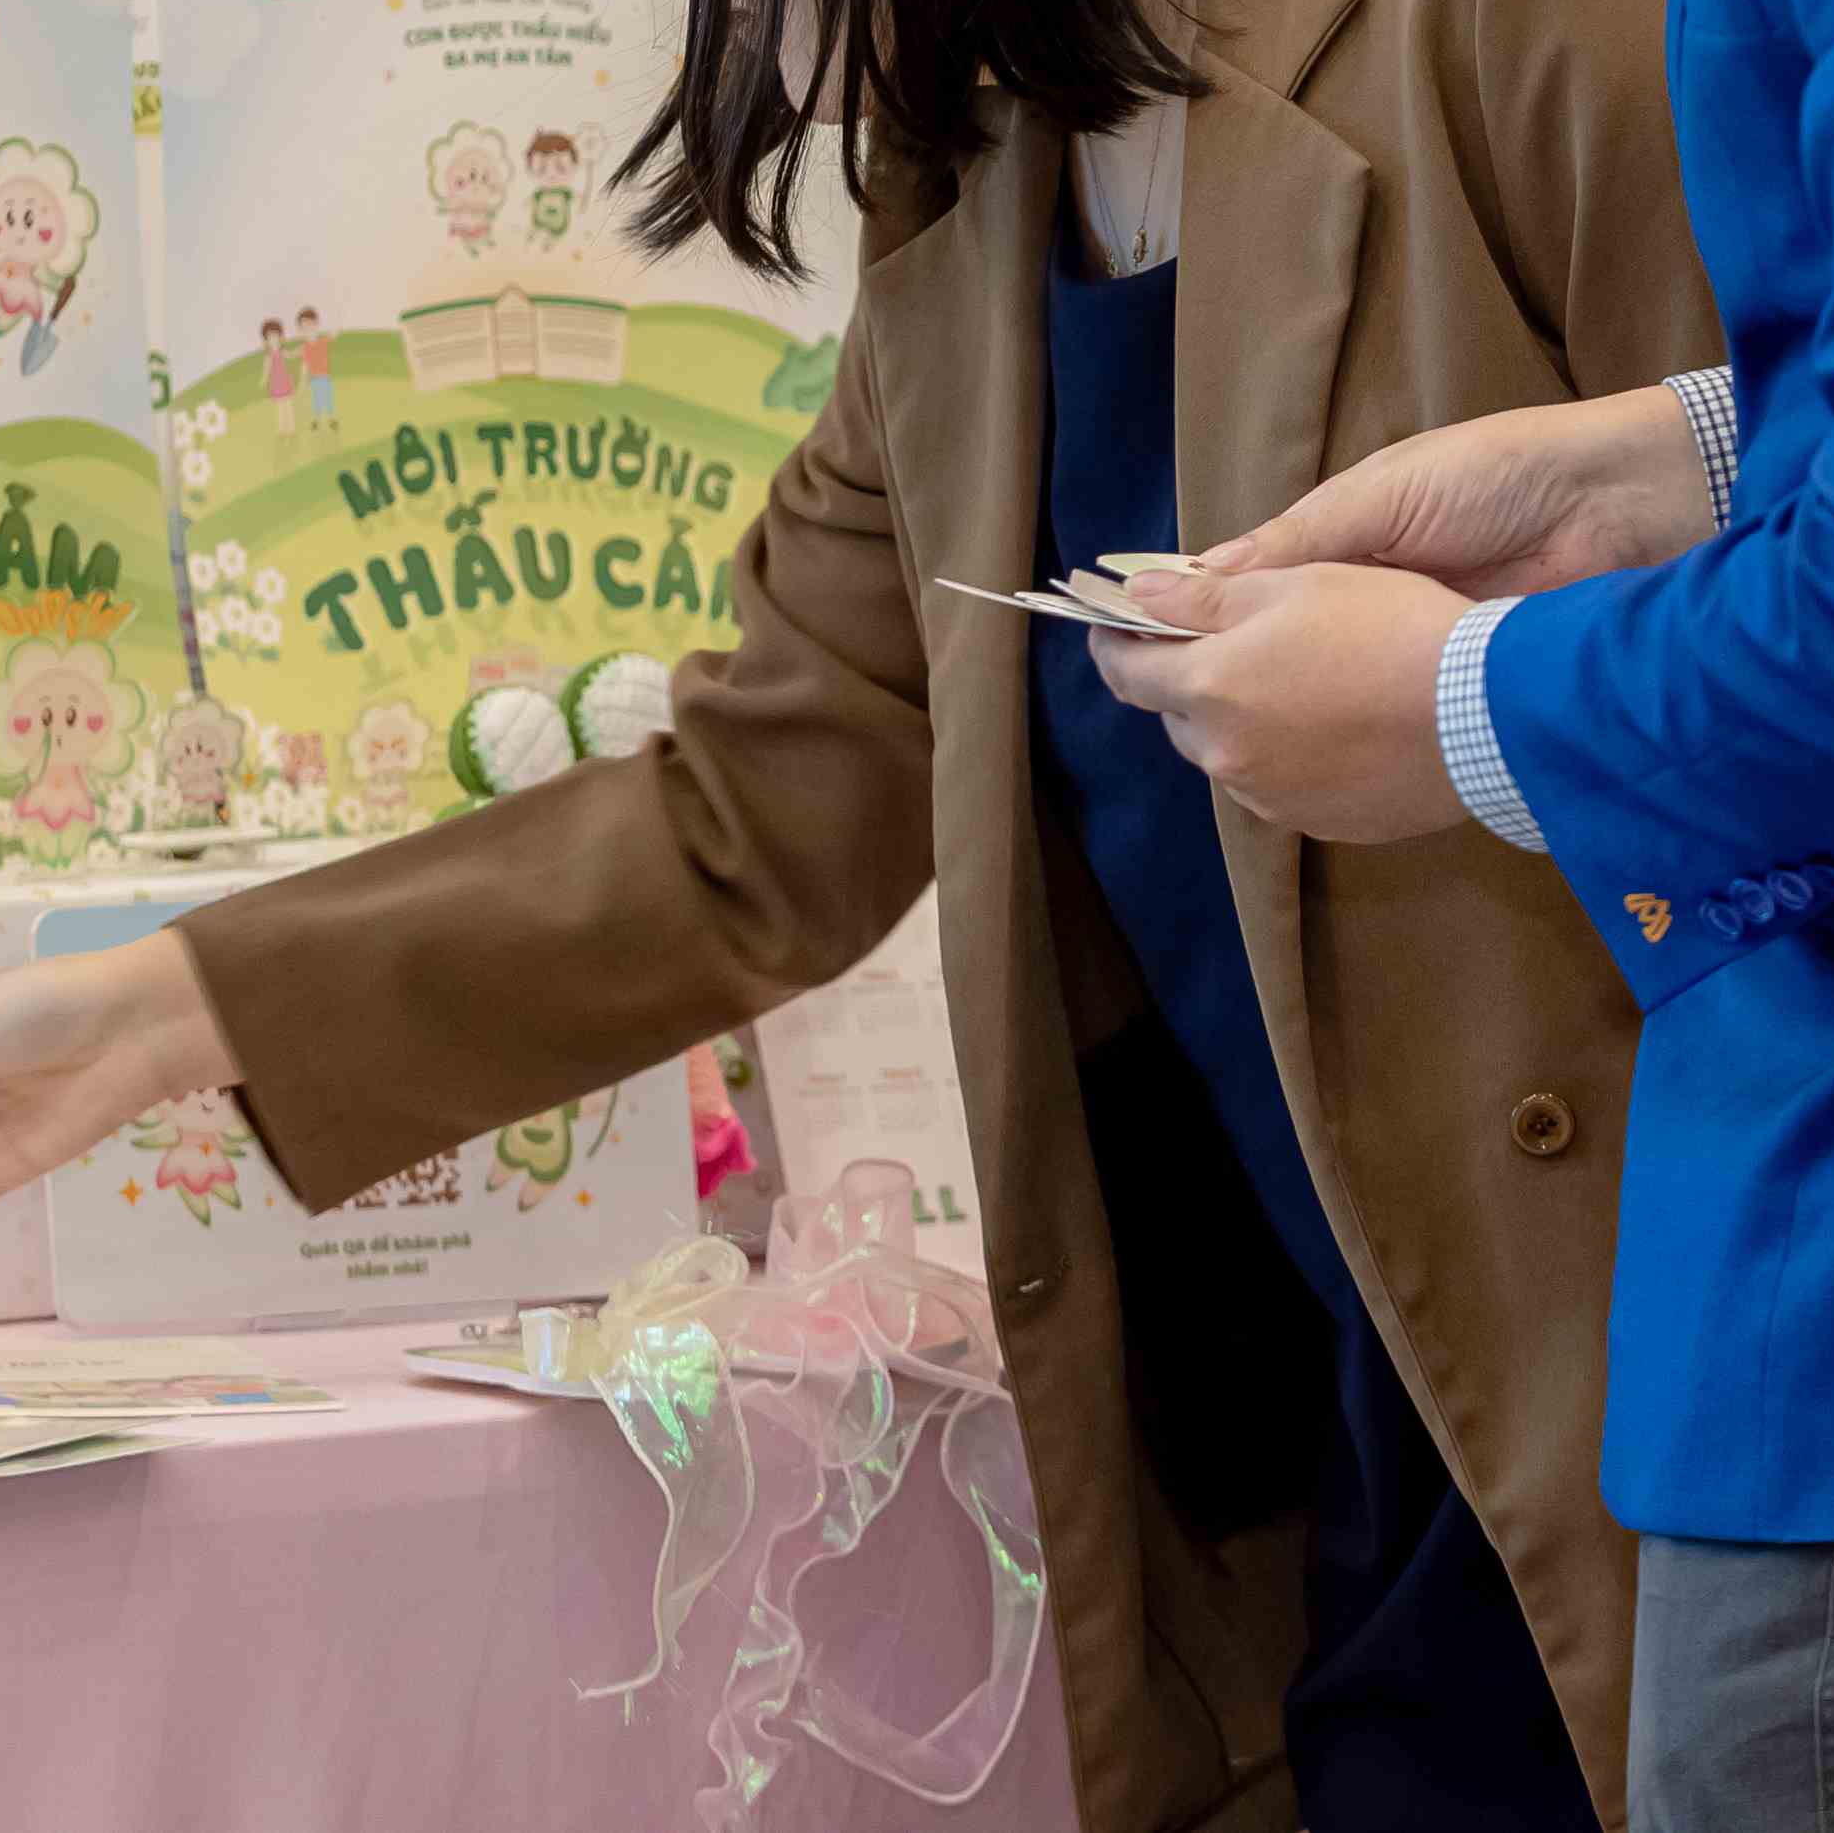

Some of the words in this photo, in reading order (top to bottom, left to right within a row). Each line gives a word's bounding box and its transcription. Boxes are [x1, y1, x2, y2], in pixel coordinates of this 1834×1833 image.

[337, 422, 458, 521] MÔI
[476, 414, 736, 514] TRƯỜNG
[302, 490, 573, 652] THẤU
